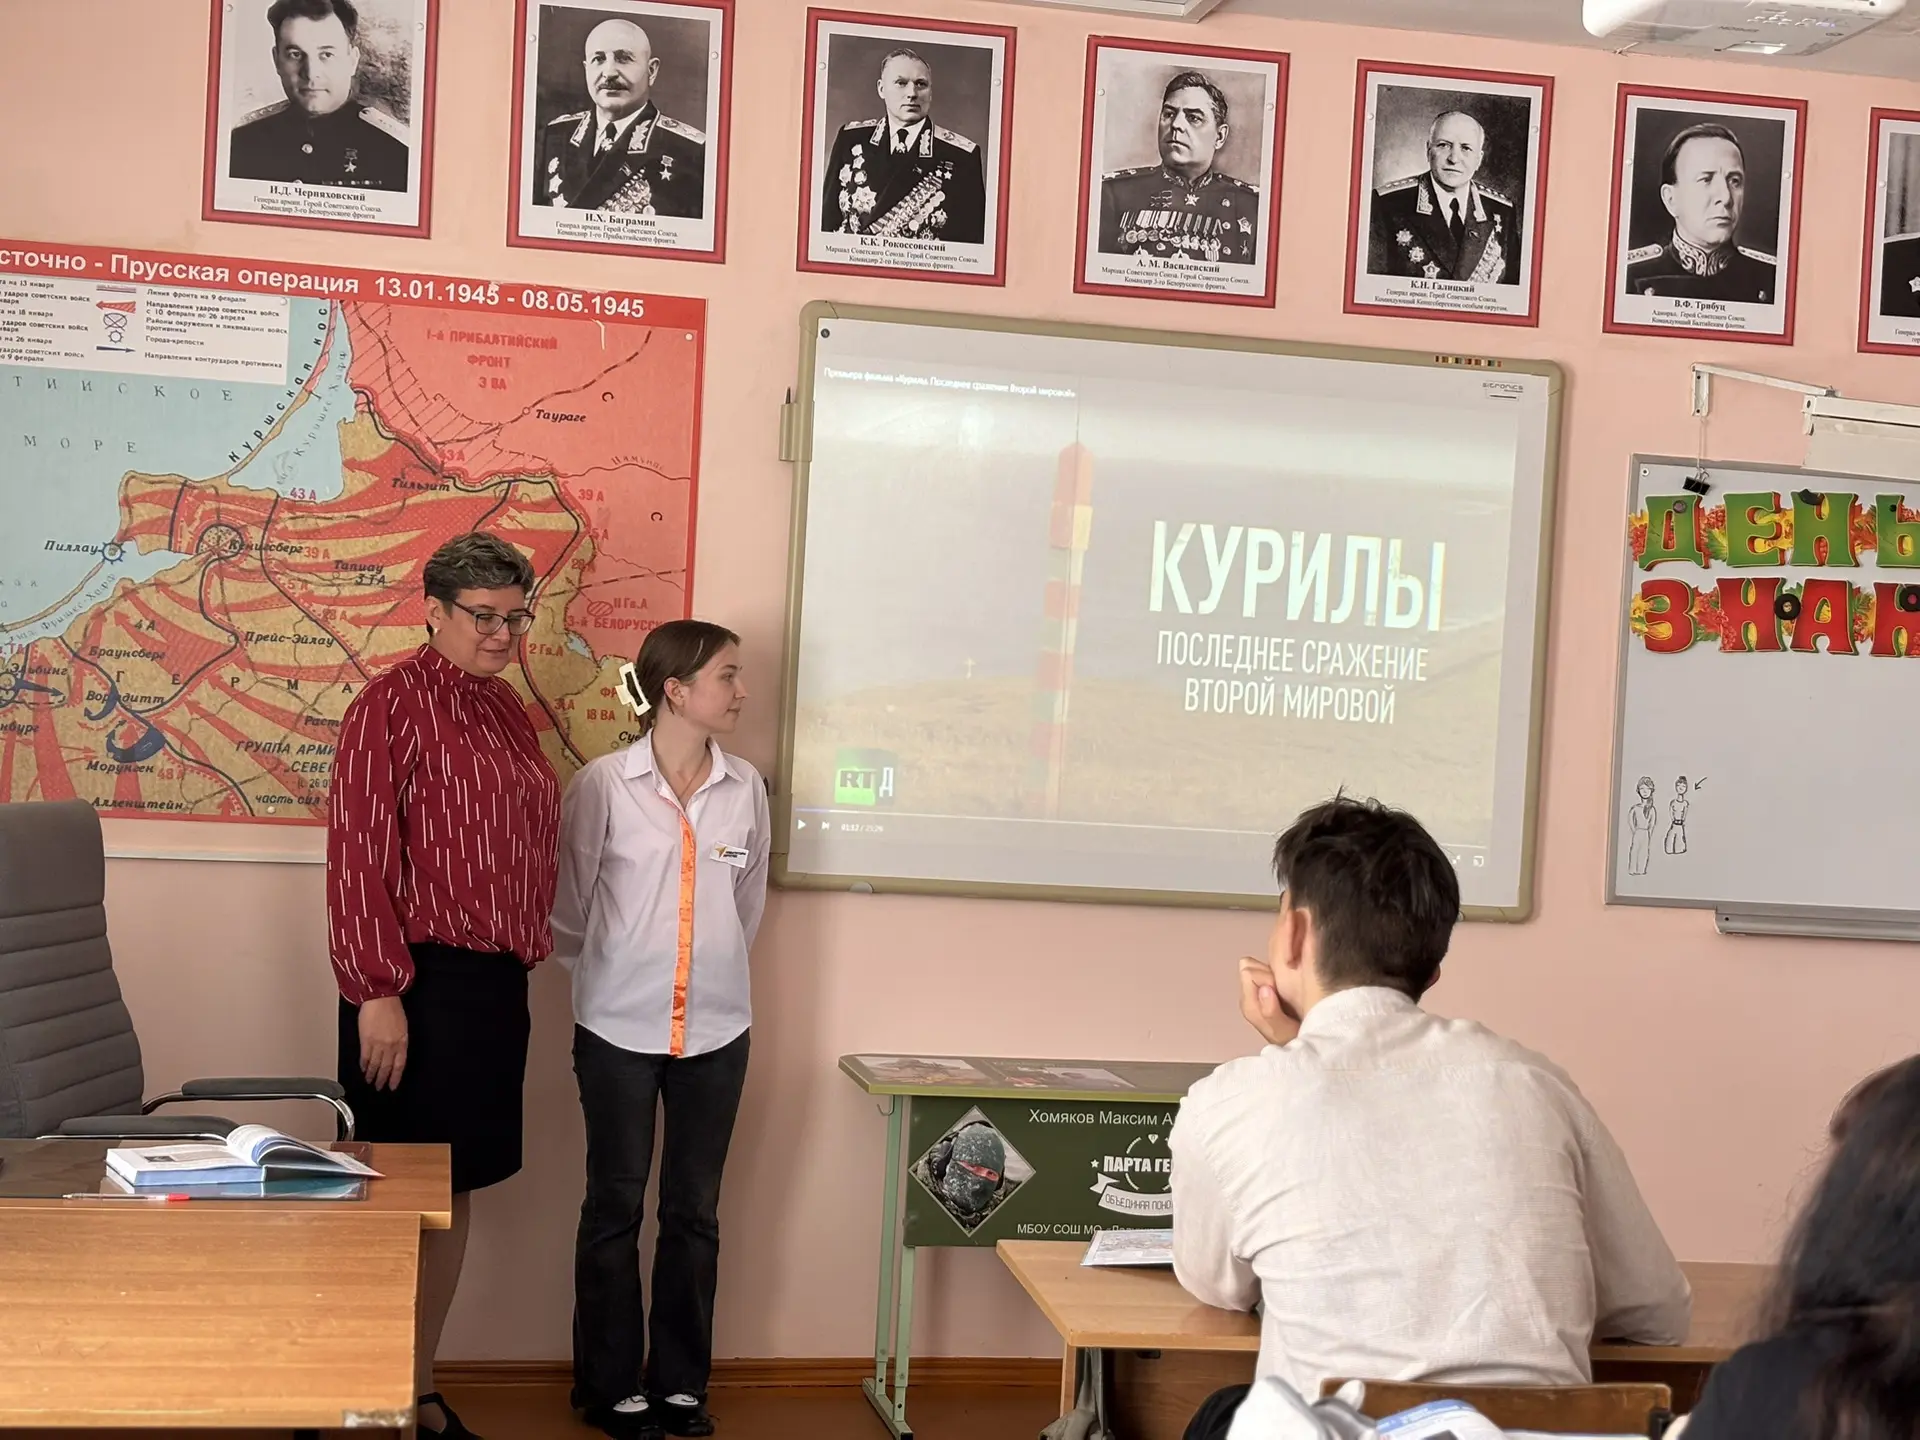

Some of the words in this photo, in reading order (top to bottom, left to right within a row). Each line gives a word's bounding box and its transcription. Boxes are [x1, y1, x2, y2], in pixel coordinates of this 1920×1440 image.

[270, 185, 292, 196] И.Д.
[294, 187, 366, 202] Черняховский
[585, 213, 606, 223] И.Х.
[608, 214, 656, 227] Баграмян
[860, 237, 880, 247] К.К.
[882, 239, 946, 252] Рокоссовский
[1136, 259, 1147, 268] А.
[1148, 261, 1161, 269] М.
[1162, 261, 1220, 273] Василевский
[110, 253, 230, 283] Прусская
[237, 268, 359, 294] операция
[374, 276, 500, 306] 13.01.1945
[521, 290, 645, 318] 08.05.1945
[1410, 280, 1430, 290] К.Н.
[1432, 282, 1475, 293] Галицкий
[1674, 300, 1693, 308] В.Ф.
[1695, 301, 1727, 312] Трибуц
[450, 330, 558, 350] ПРИБАЛТИЙСКИЙ
[467, 354, 511, 368] ФРОНТ
[536, 409, 587, 424] Таураге
[290, 488, 306, 500] 43
[578, 488, 594, 500] 39
[1638, 491, 1920, 572] ДЕНЬ
[44, 540, 98, 555] Пиллау
[304, 546, 320, 558] 39
[1149, 520, 1446, 632] КУРИЛЫ
[244, 631, 336, 648] Прейс-Эйлау
[89, 646, 166, 660] Браунсберг
[1157, 629, 1296, 676] ПОСЛЕДНЕЕ
[1301, 640, 1429, 682] СРАЖЕНИЕ
[86, 691, 165, 704] Вордитт
[1184, 676, 1275, 717] ВТОРОЙ
[1283, 684, 1396, 725] МИРОВОЙ
[236, 740, 290, 754] ГРУППА
[92, 796, 184, 811] Алленштейн
[1028, 1108, 1095, 1124] Хомяков
[1100, 1111, 1158, 1126] Максим
[1162, 1113, 1175, 1126] А
[1104, 1156, 1152, 1172] ПАРТА
[1154, 1158, 1171, 1172] ГЕ
[1017, 1224, 1050, 1234] МБОУ
[1053, 1224, 1080, 1234] СОШ
